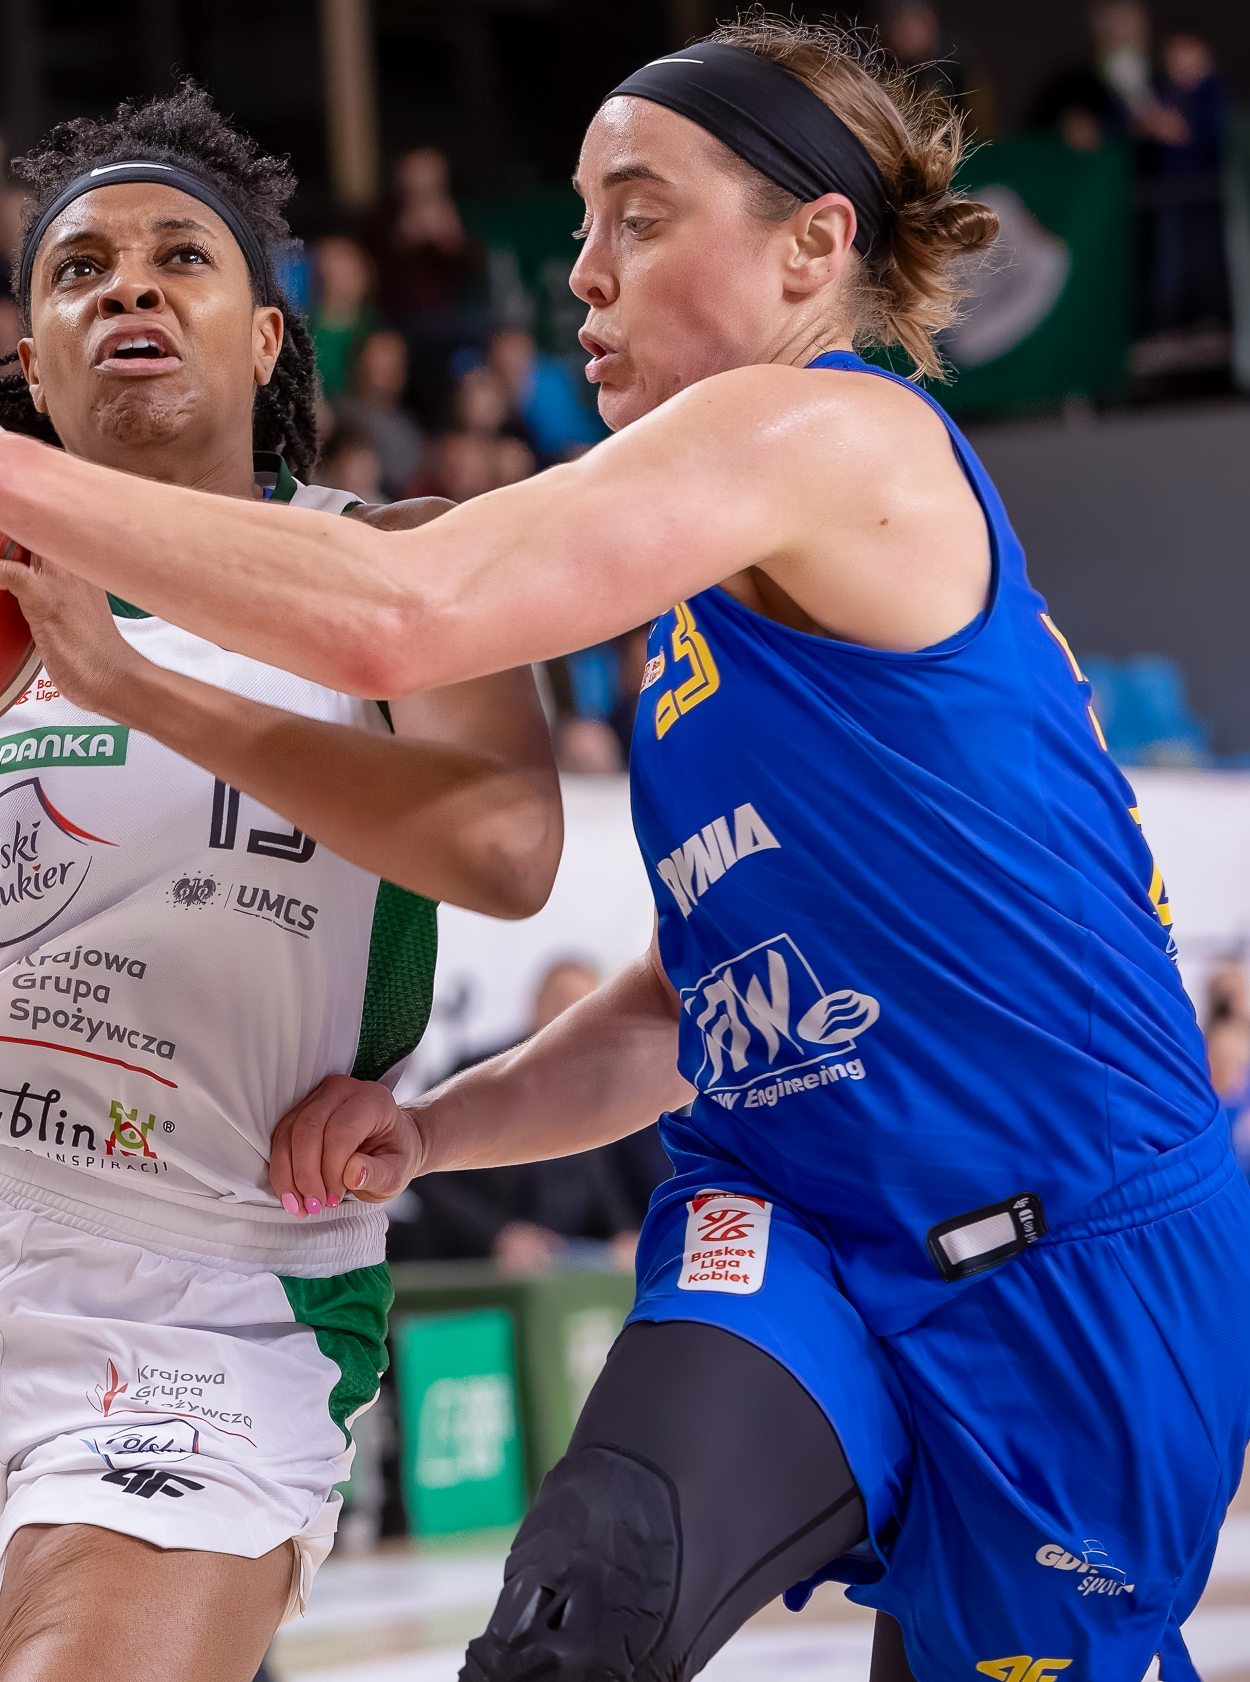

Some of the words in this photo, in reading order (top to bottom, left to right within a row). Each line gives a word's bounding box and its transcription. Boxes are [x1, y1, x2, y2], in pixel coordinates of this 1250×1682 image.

[236, 885, 319, 931] UMCS
[12, 973, 111, 1004] Grupa
[9, 998, 176, 1060] Spożywcza
[690, 1246, 756, 1264] Basket
[700, 1258, 741, 1270] Liga
[687, 1270, 750, 1285] Kobiet
[137, 1365, 226, 1385] Krajowa
[135, 1385, 203, 1400] Grupa
